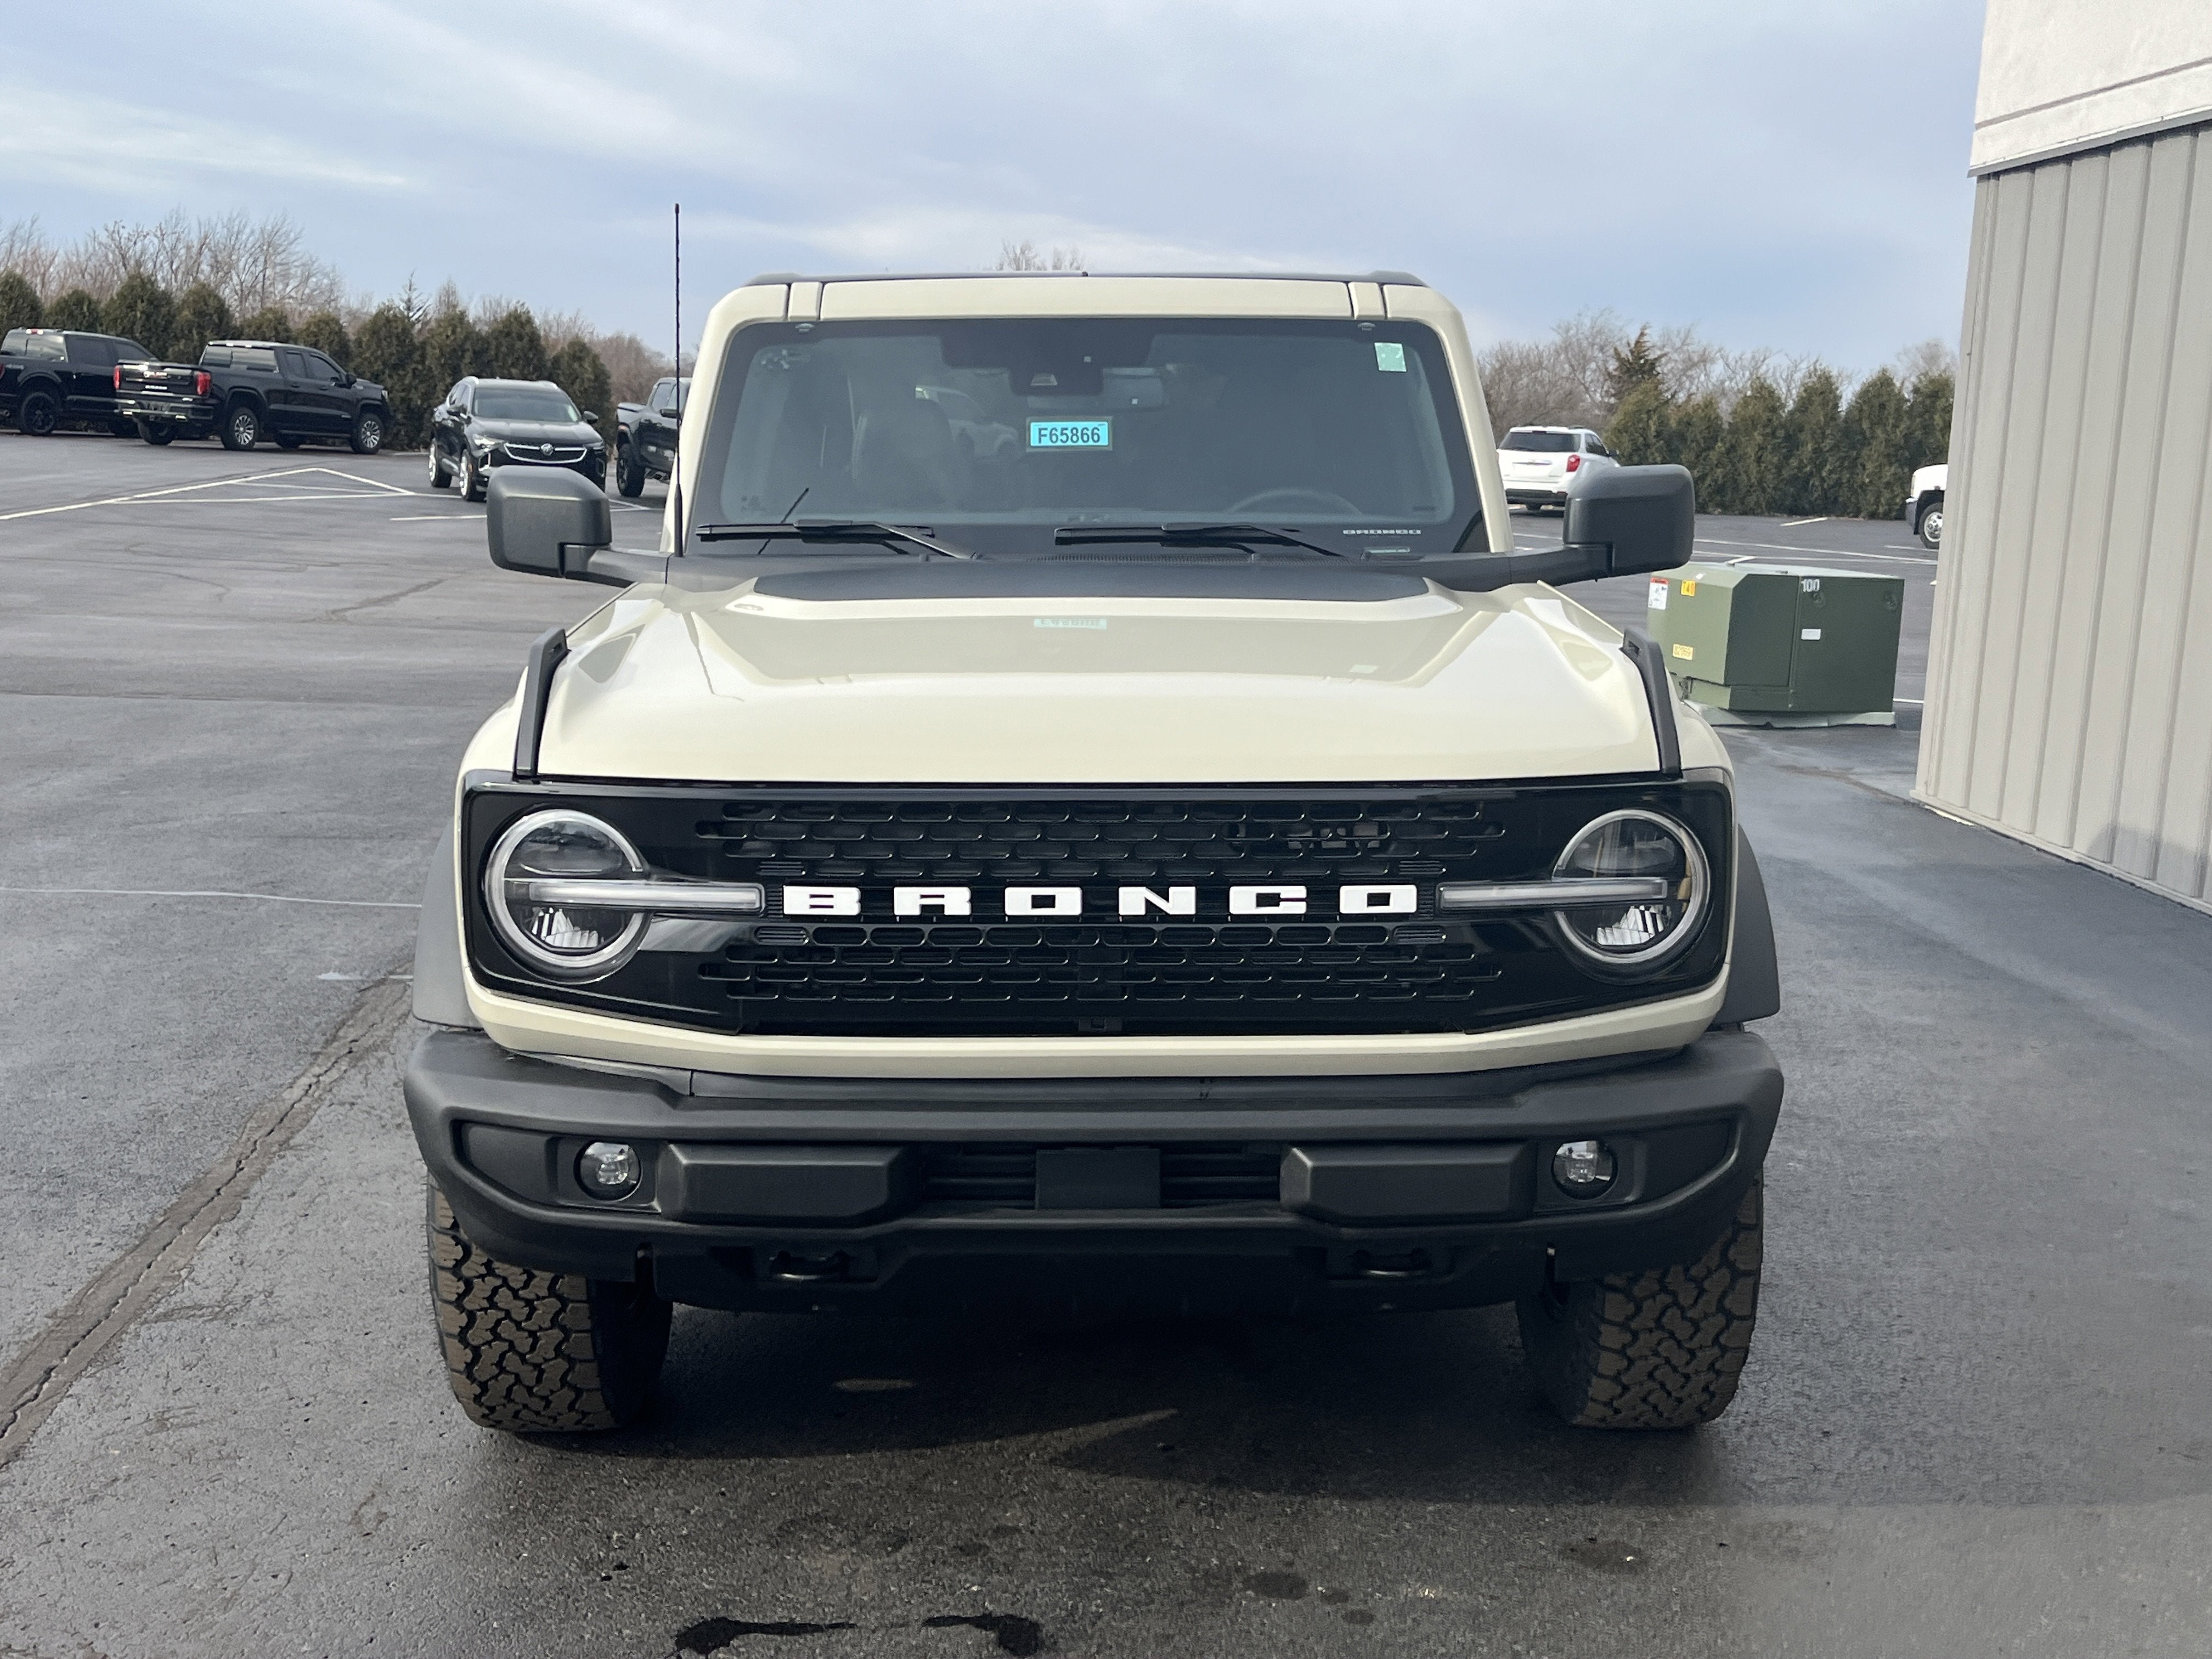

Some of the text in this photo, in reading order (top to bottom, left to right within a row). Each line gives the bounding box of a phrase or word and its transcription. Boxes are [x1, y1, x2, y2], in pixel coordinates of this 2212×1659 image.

[1038, 426, 1101, 444] F65866
[1801, 579, 1820, 592] 100
[783, 884, 1417, 916] BRONCO
